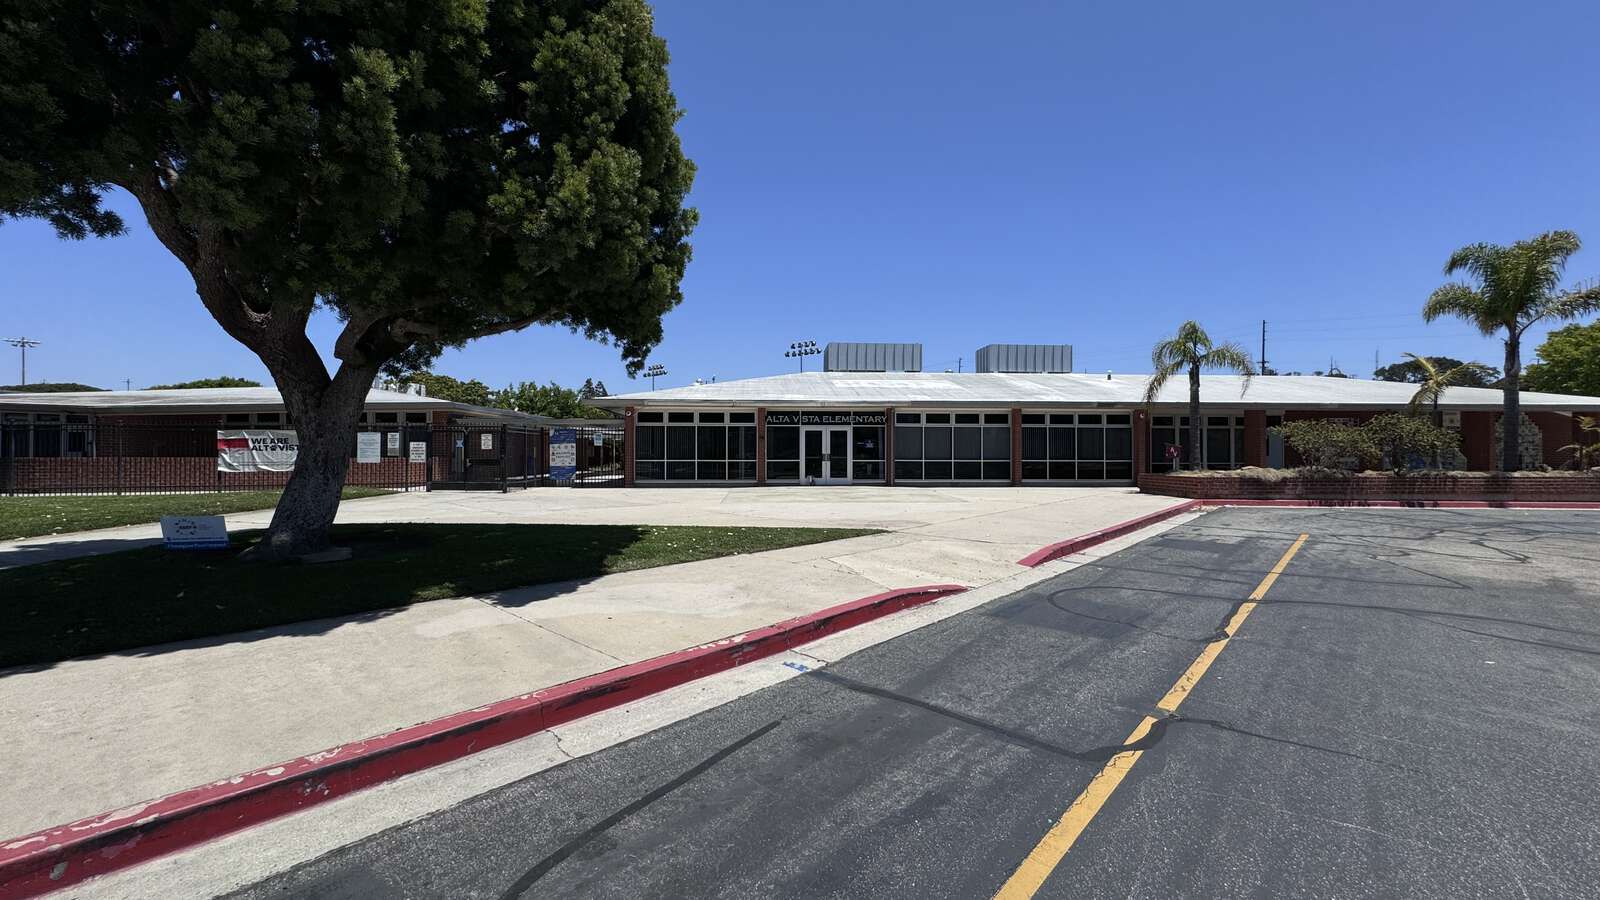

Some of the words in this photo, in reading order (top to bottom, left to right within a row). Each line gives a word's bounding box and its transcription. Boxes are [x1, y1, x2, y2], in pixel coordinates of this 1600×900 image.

[766, 415, 789, 423] ALTA
[793, 415, 820, 423] VISTA
[822, 415, 888, 423] ELEMENTARY
[251, 437, 268, 445] WE
[269, 437, 289, 445] ARE
[278, 444, 299, 452] VIST
